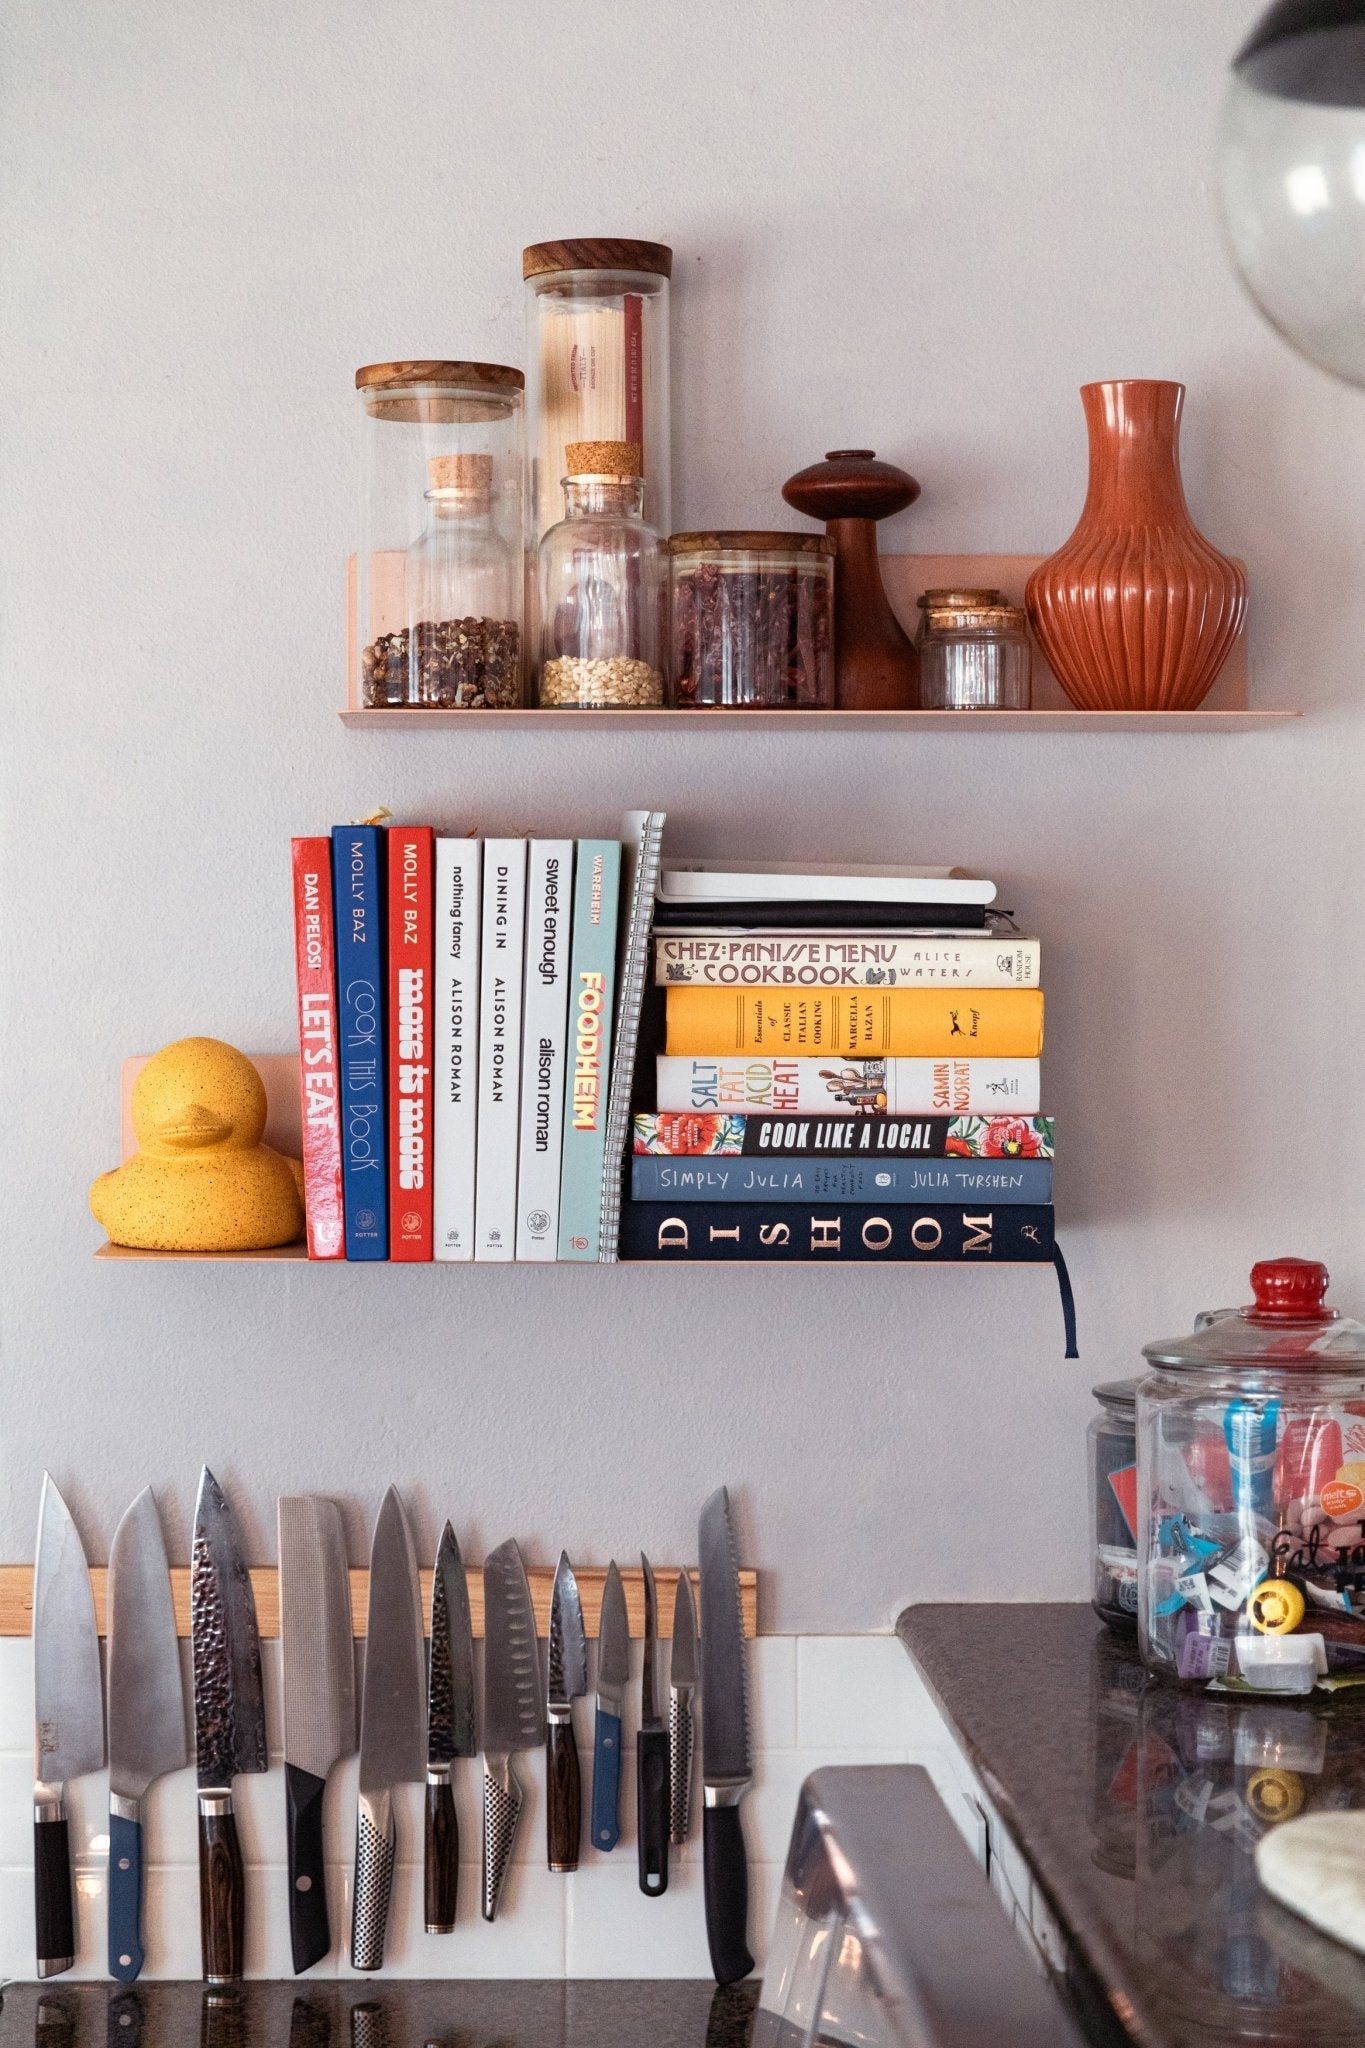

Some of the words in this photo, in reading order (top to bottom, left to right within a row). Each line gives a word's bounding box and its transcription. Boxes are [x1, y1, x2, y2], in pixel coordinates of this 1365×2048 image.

[304, 873, 320, 910] DAN
[351, 842, 365, 901] MOLLY
[403, 844, 418, 903] MOLLY
[449, 866, 464, 918] nothing
[544, 858, 560, 915] sweet
[590, 854, 603, 925] WAREHEIM
[496, 866, 508, 926] DINING
[305, 915, 322, 969] PELOSI
[352, 908, 366, 943] BAZ
[403, 910, 418, 945] BAZ
[449, 921, 464, 959] fancy
[495, 932, 507, 949] IN
[538, 918, 559, 985] enough
[703, 963, 860, 985] COOKBOOK
[825, 944, 898, 963] MENU
[899, 967, 973, 977] WATERS
[913, 952, 961, 962] ALICE
[1024, 954, 1032, 979] HOUSE
[302, 993, 333, 1066] LET'S
[398, 968, 425, 1060] more
[451, 978, 463, 1038] ALISON
[494, 978, 505, 1037] ALISON
[754, 1000, 763, 1044] Essentials
[768, 1016, 778, 1027] of
[783, 1002, 791, 1042] CLASSIC
[798, 1001, 806, 1043] ITALIAN
[813, 1000, 822, 1045] COOKING
[849, 995, 858, 1050] MARCELLA
[865, 1005, 873, 1041] HAZAN
[969, 1007, 980, 1037] Knopf
[450, 1044, 462, 1103] ROMAN
[492, 1044, 504, 1102] ROMAN
[538, 1038, 555, 1090] alison
[572, 972, 606, 1130] FOODHEIM
[305, 1072, 336, 1129] EAT
[691, 1061, 719, 1108] SALT
[718, 1066, 745, 1103] FAT
[745, 1063, 772, 1106] ACID
[772, 1059, 800, 1110] HEAT
[933, 1063, 950, 1108] SAMIN
[953, 1061, 970, 1111] NOSRAT
[399, 1098, 424, 1190] more
[535, 1094, 551, 1152] roman
[758, 1122, 809, 1148] COOK
[814, 1122, 855, 1149] LIKE
[859, 1123, 871, 1149] A
[877, 1123, 932, 1149] LOCAL
[660, 1168, 730, 1189] SIMPLY
[743, 1169, 804, 1190] JULIA
[909, 1170, 950, 1188] JULIA
[955, 1172, 1024, 1188] TURSHEN
[657, 1211, 994, 1255] DISHOOM
